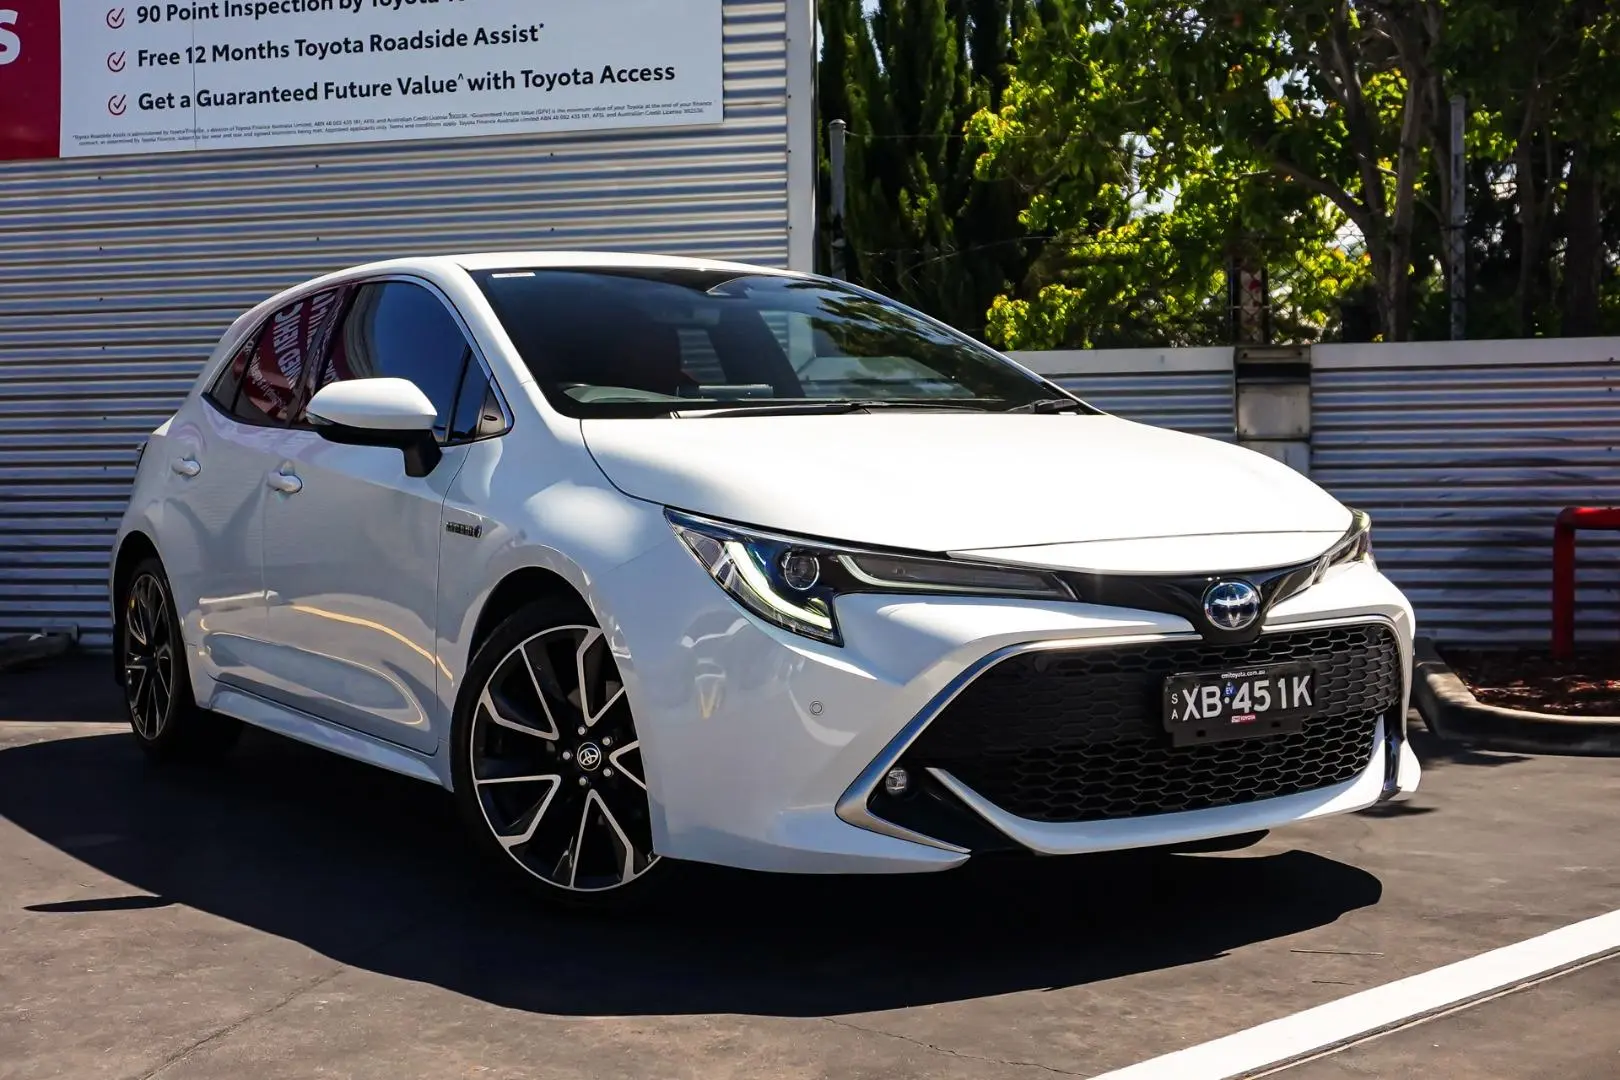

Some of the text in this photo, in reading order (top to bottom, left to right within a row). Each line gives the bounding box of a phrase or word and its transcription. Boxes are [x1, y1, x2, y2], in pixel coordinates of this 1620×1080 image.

[136, 5, 161, 24] 90
[166, 1, 220, 22] Point
[224, 0, 334, 20] Inspection
[137, 49, 181, 68] Free
[185, 46, 207, 64] 12
[211, 41, 290, 63] Months
[294, 37, 364, 60] Toyota
[369, 28, 469, 53] Roadside
[138, 92, 176, 111] Get
[179, 95, 191, 109] a
[196, 81, 318, 108] Guaranteed
[323, 79, 393, 100] Future
[466, 71, 515, 92] with
[520, 68, 594, 92] Toyota
[599, 64, 676, 84] Access
